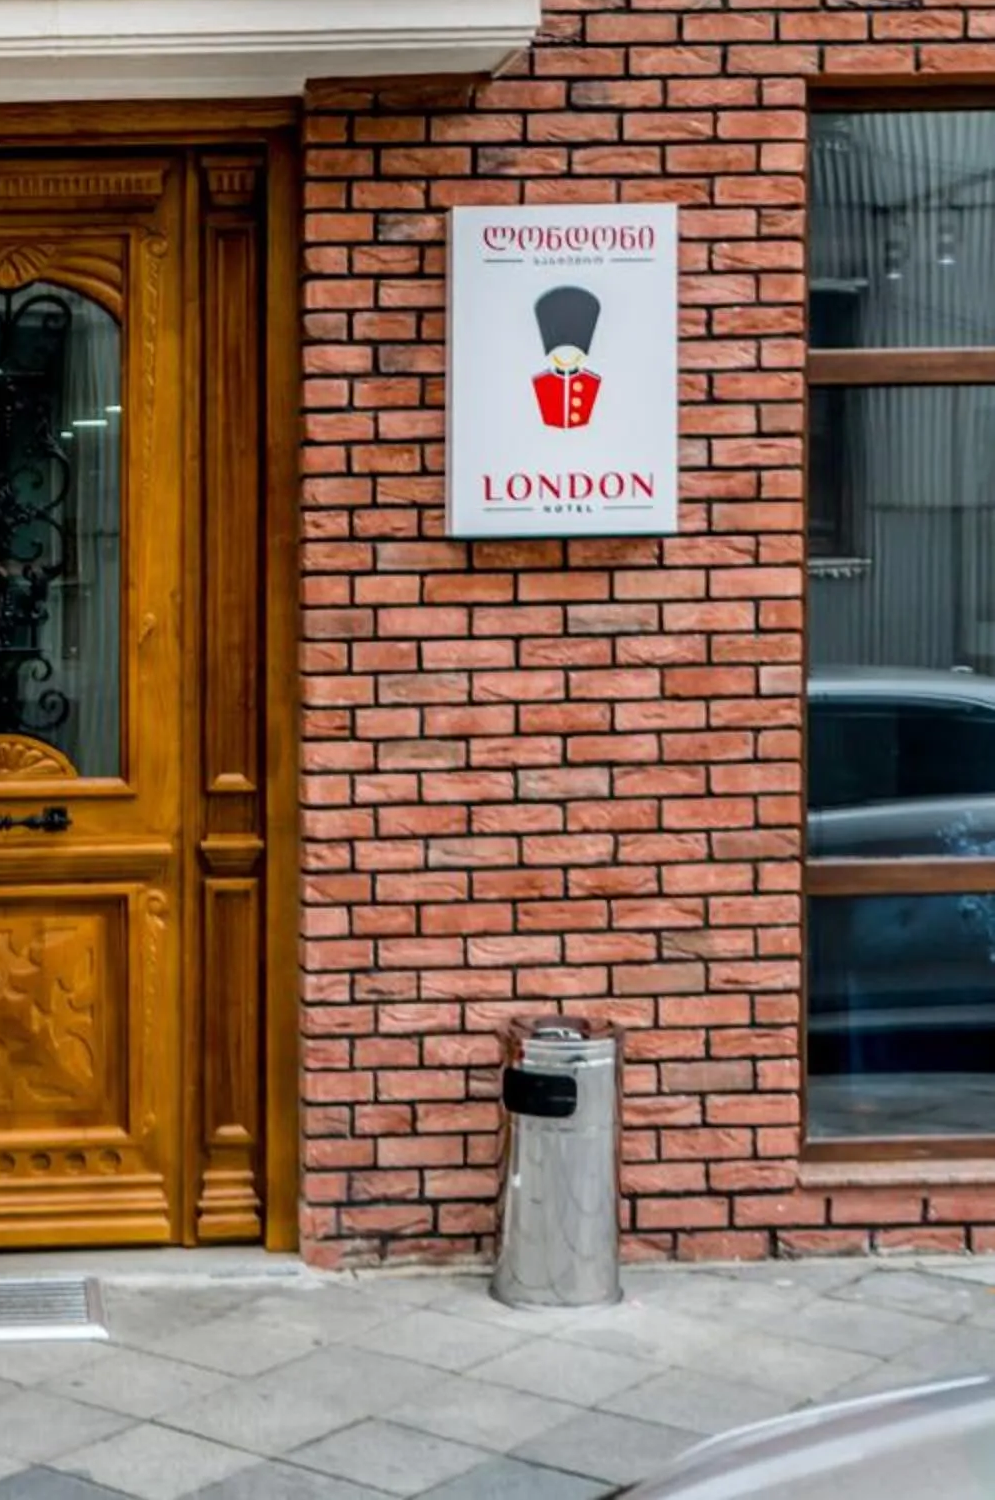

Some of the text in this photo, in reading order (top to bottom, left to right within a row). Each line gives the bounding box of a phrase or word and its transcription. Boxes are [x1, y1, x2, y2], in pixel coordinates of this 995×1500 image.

[483, 225, 655, 251] ლონდონი
[482, 471, 654, 501] LONDON
[543, 504, 593, 514] HOTEL
